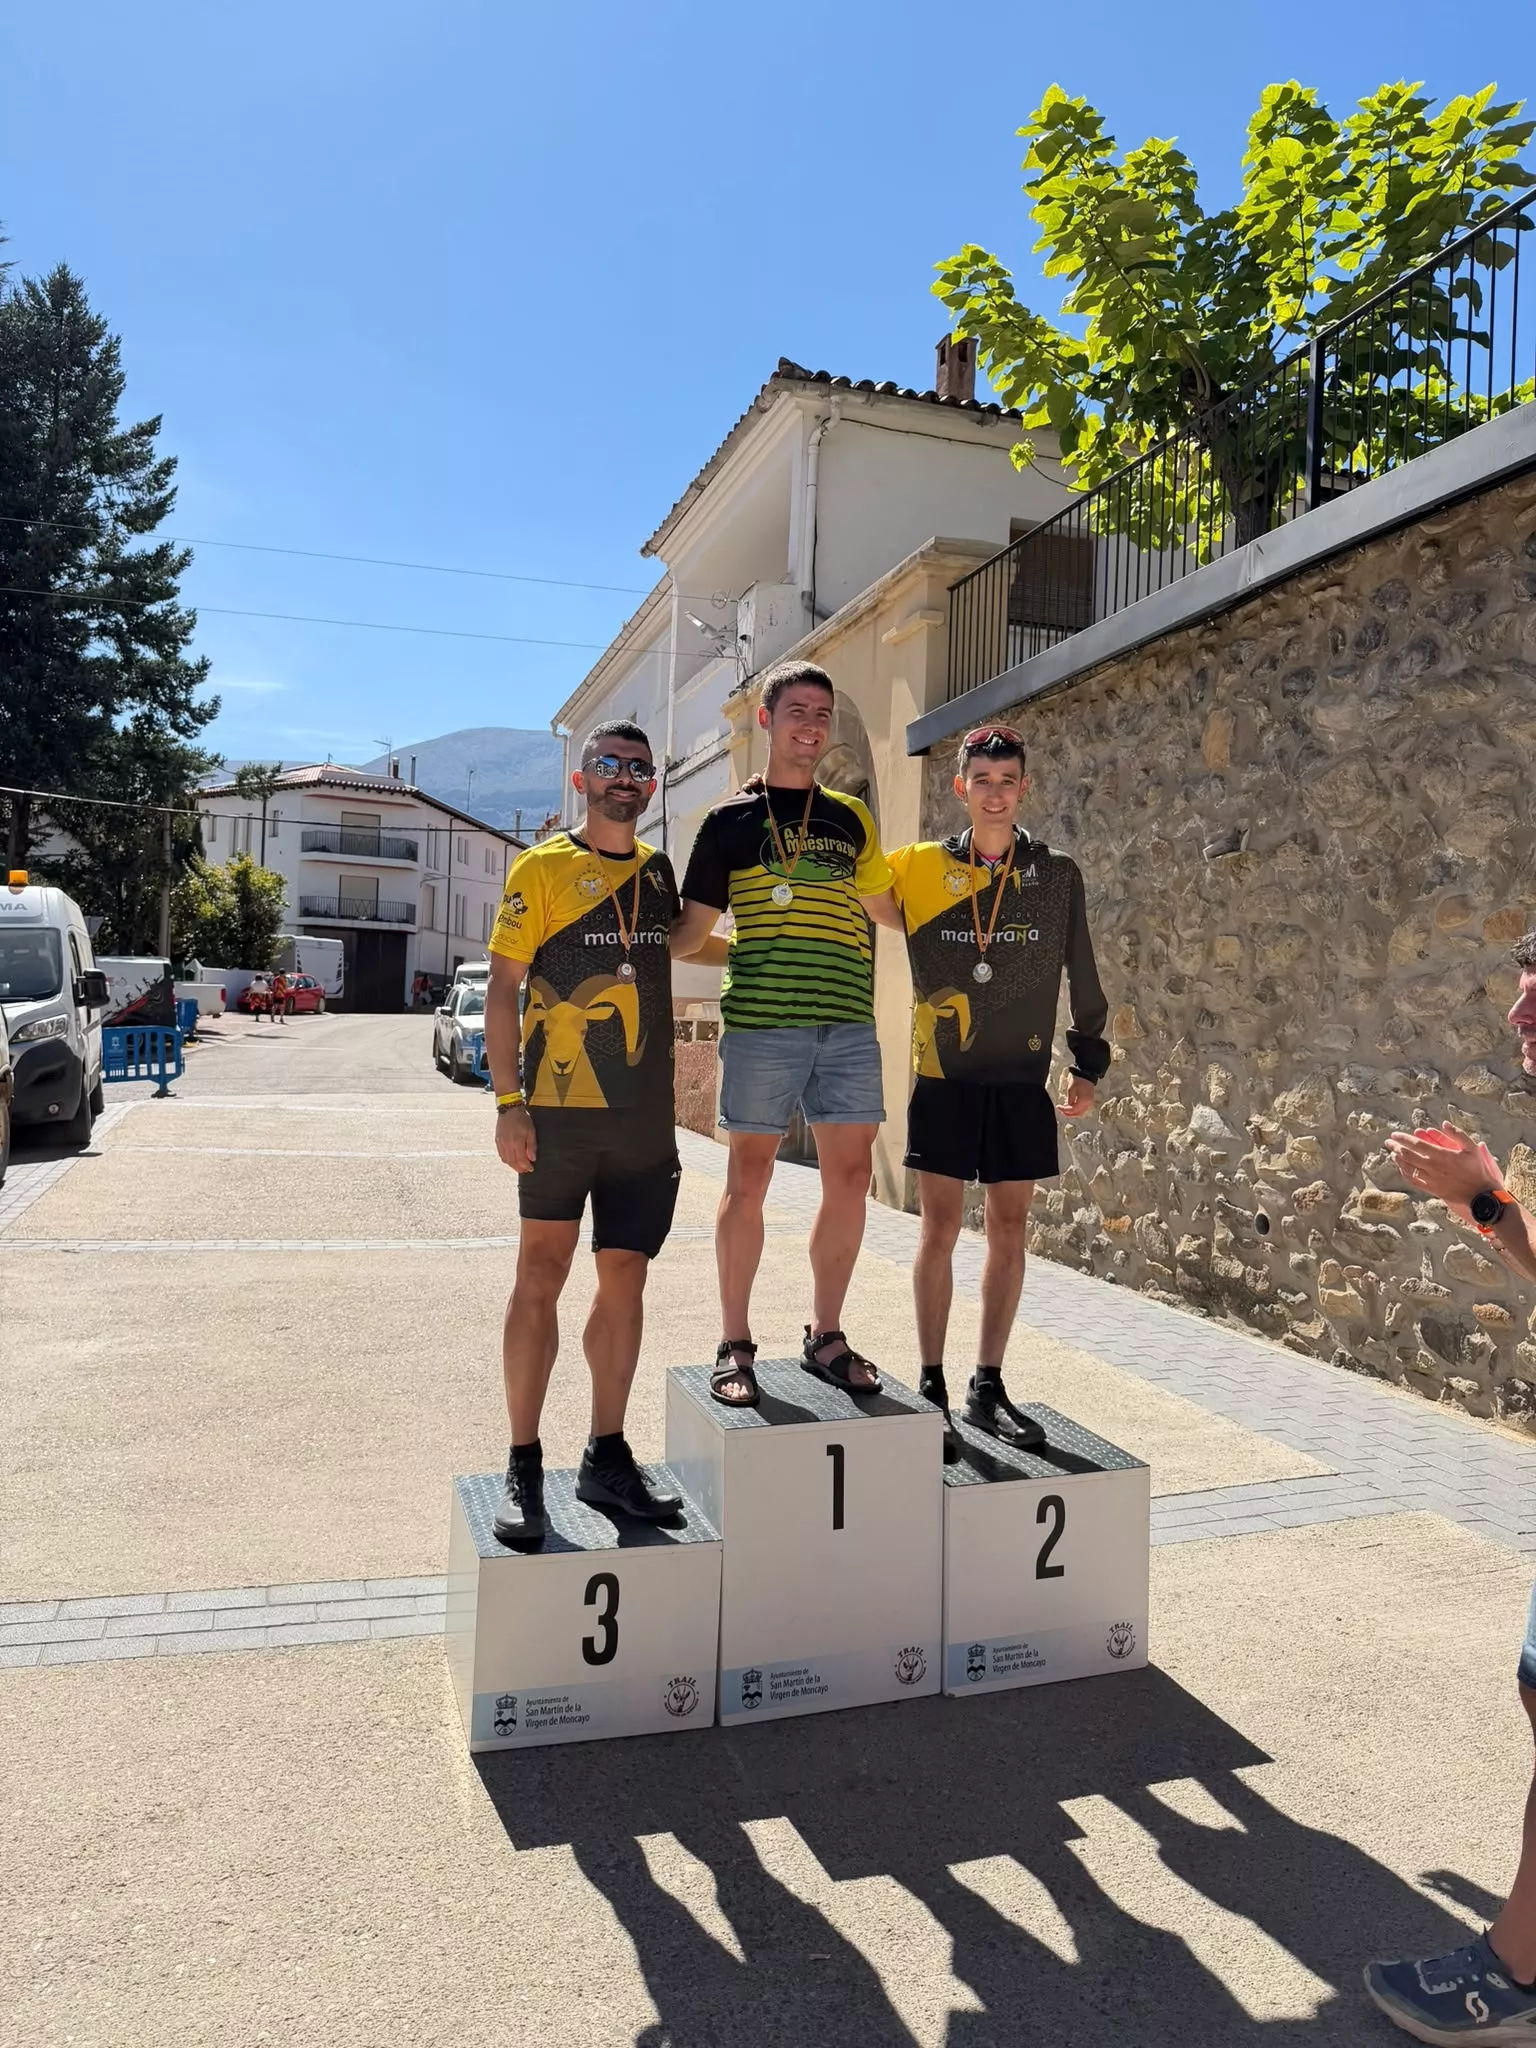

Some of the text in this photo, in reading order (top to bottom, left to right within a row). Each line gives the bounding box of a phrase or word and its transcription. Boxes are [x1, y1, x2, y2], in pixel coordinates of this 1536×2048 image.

[826, 1444, 845, 1530] 1
[1035, 1494, 1066, 1580] 2
[582, 1572, 620, 1666] 3
[1109, 1622, 1133, 1633] TRAIL
[897, 1646, 924, 1657] TRAIL
[993, 1655, 1003, 1663] San
[1025, 1650, 1032, 1658] de
[993, 1659, 1046, 1674] Virgen de Moncayo
[667, 1676, 696, 1688] TRAIL
[770, 1681, 782, 1689] San
[806, 1676, 813, 1684] de
[770, 1685, 828, 1701] Virgen de Moncayo
[526, 1708, 539, 1717] San
[565, 1704, 573, 1712] de
[525, 1714, 590, 1729] Virgen de Moncayo
